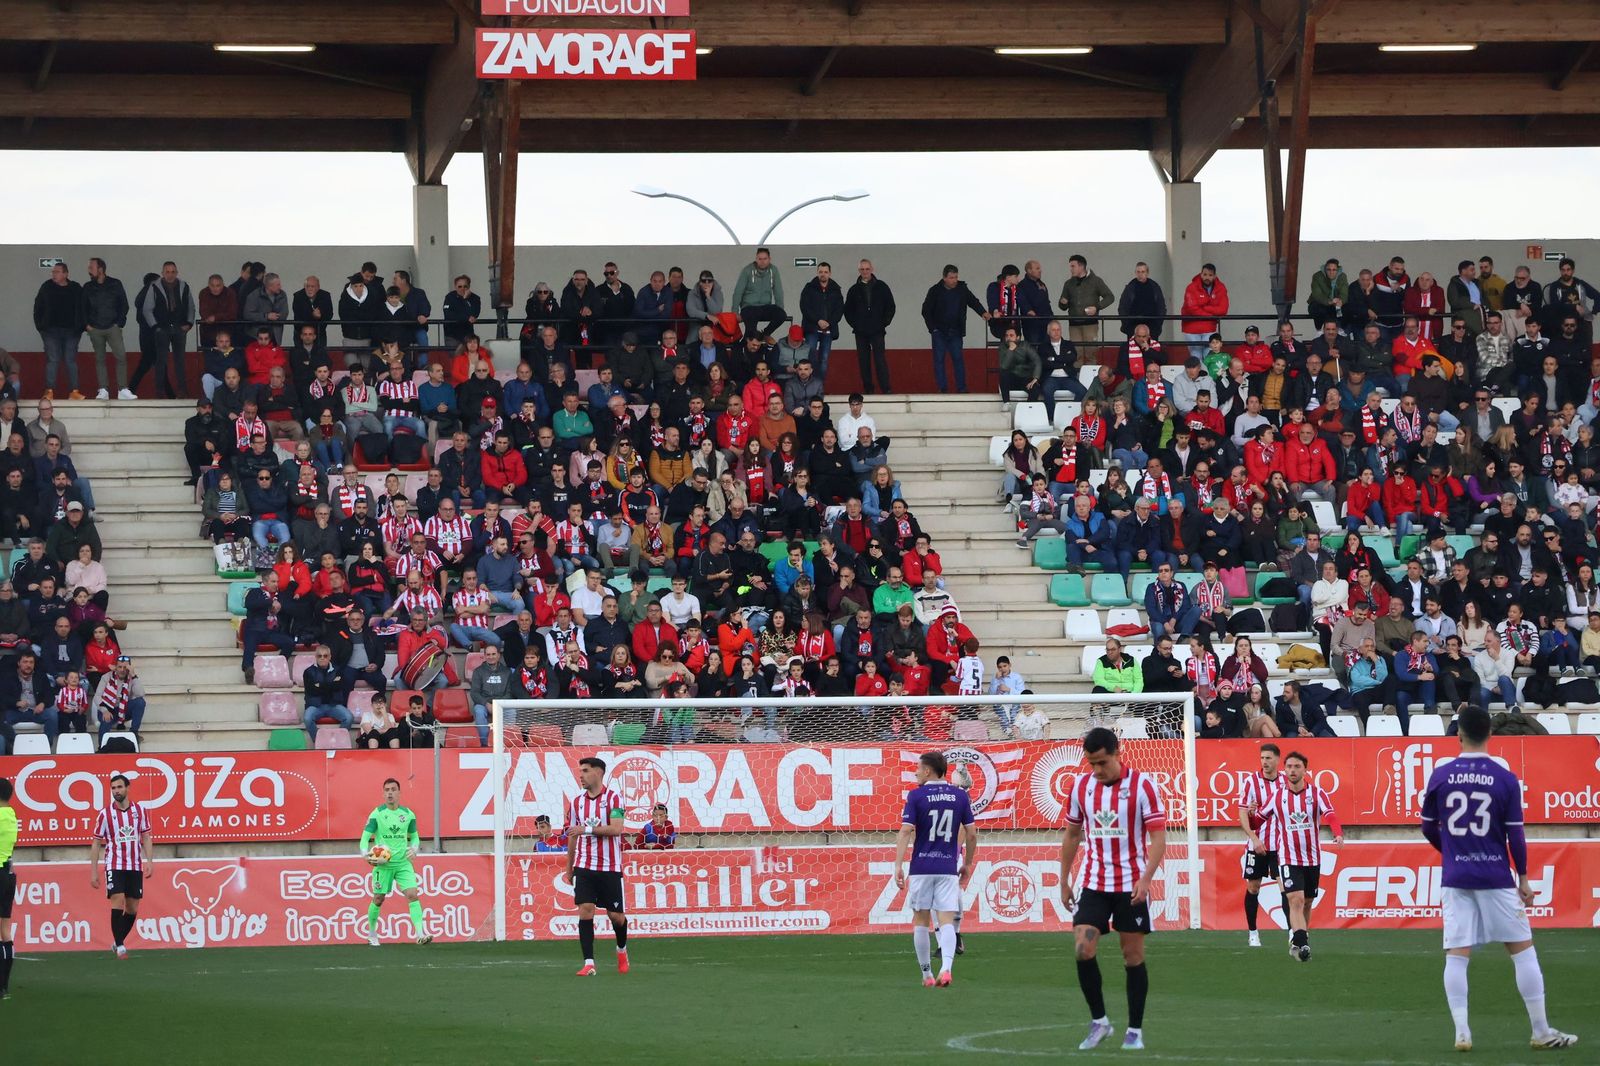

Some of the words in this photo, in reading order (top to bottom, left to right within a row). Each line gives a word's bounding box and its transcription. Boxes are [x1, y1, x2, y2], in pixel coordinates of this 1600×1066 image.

[972, 668, 980, 689] 5
[777, 747, 882, 828] CF
[1448, 773, 1494, 786] J.CASADO
[926, 793, 956, 803] TAVARES
[160, 816, 170, 828] Y
[178, 813, 286, 828] JAMONES
[1445, 790, 1493, 837] 23
[928, 809, 954, 842] 14
[107, 870, 113, 882] 2
[624, 861, 691, 880] degas
[761, 856, 794, 874] del
[1283, 865, 1290, 878] 8
[553, 865, 819, 911] Smiller
[25, 912, 91, 944] León
[555, 915, 820, 933] ww.bdegasdelsumiller.com
